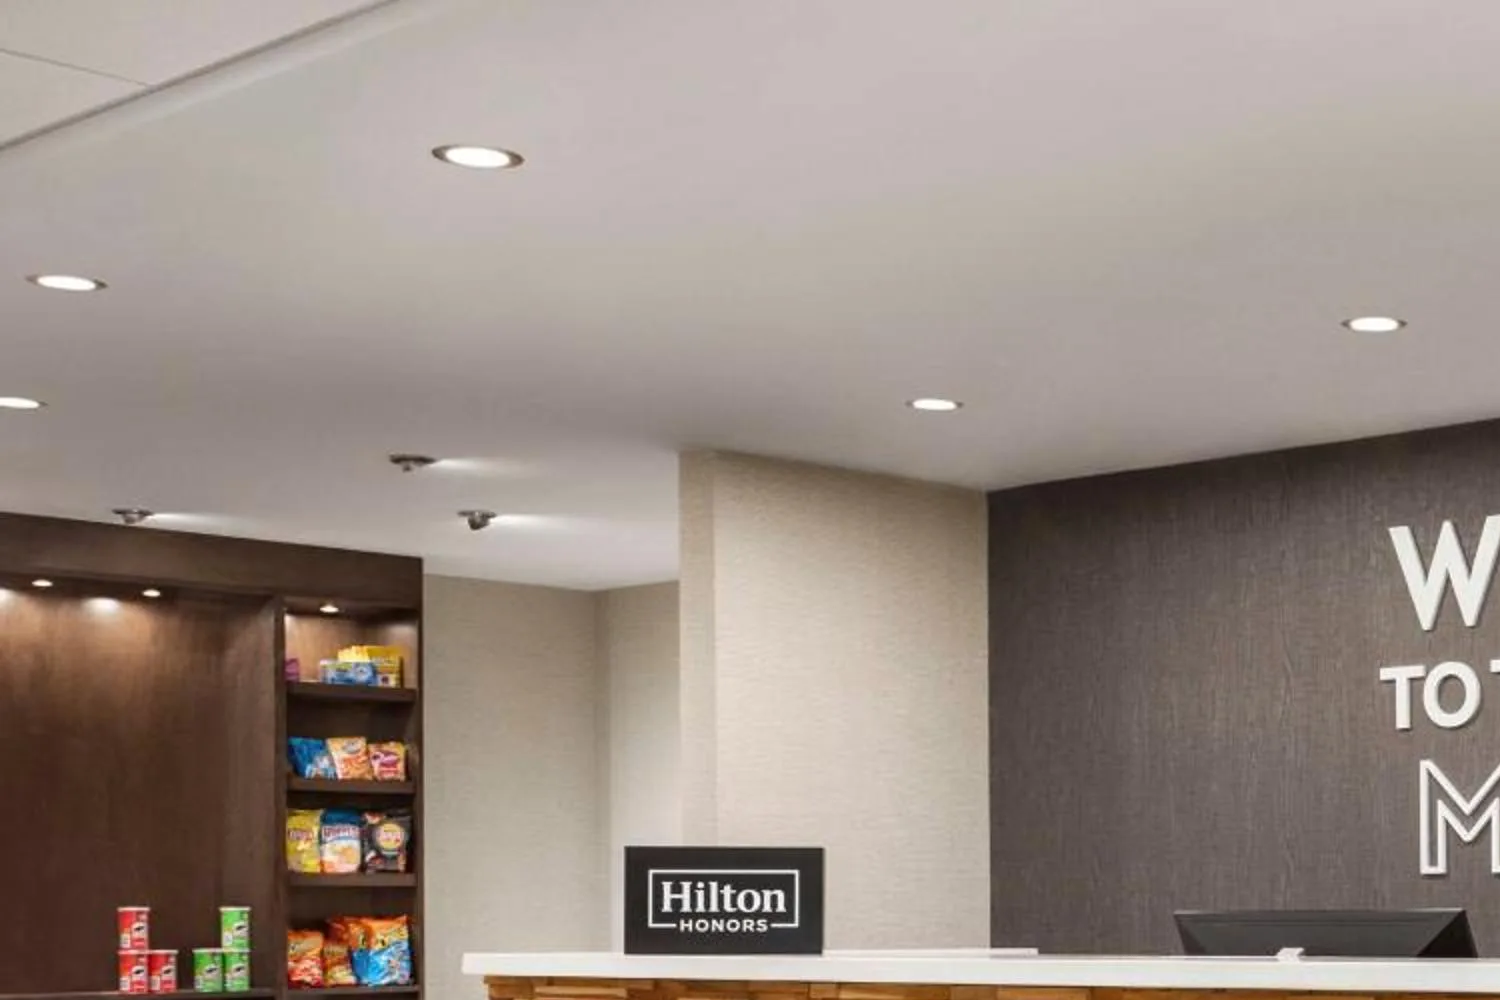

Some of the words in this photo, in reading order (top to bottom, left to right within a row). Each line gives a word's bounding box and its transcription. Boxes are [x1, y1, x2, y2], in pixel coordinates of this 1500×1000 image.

[1380, 661, 1481, 730] TO
[661, 881, 787, 913] Hilton
[679, 918, 769, 933] HONORS
